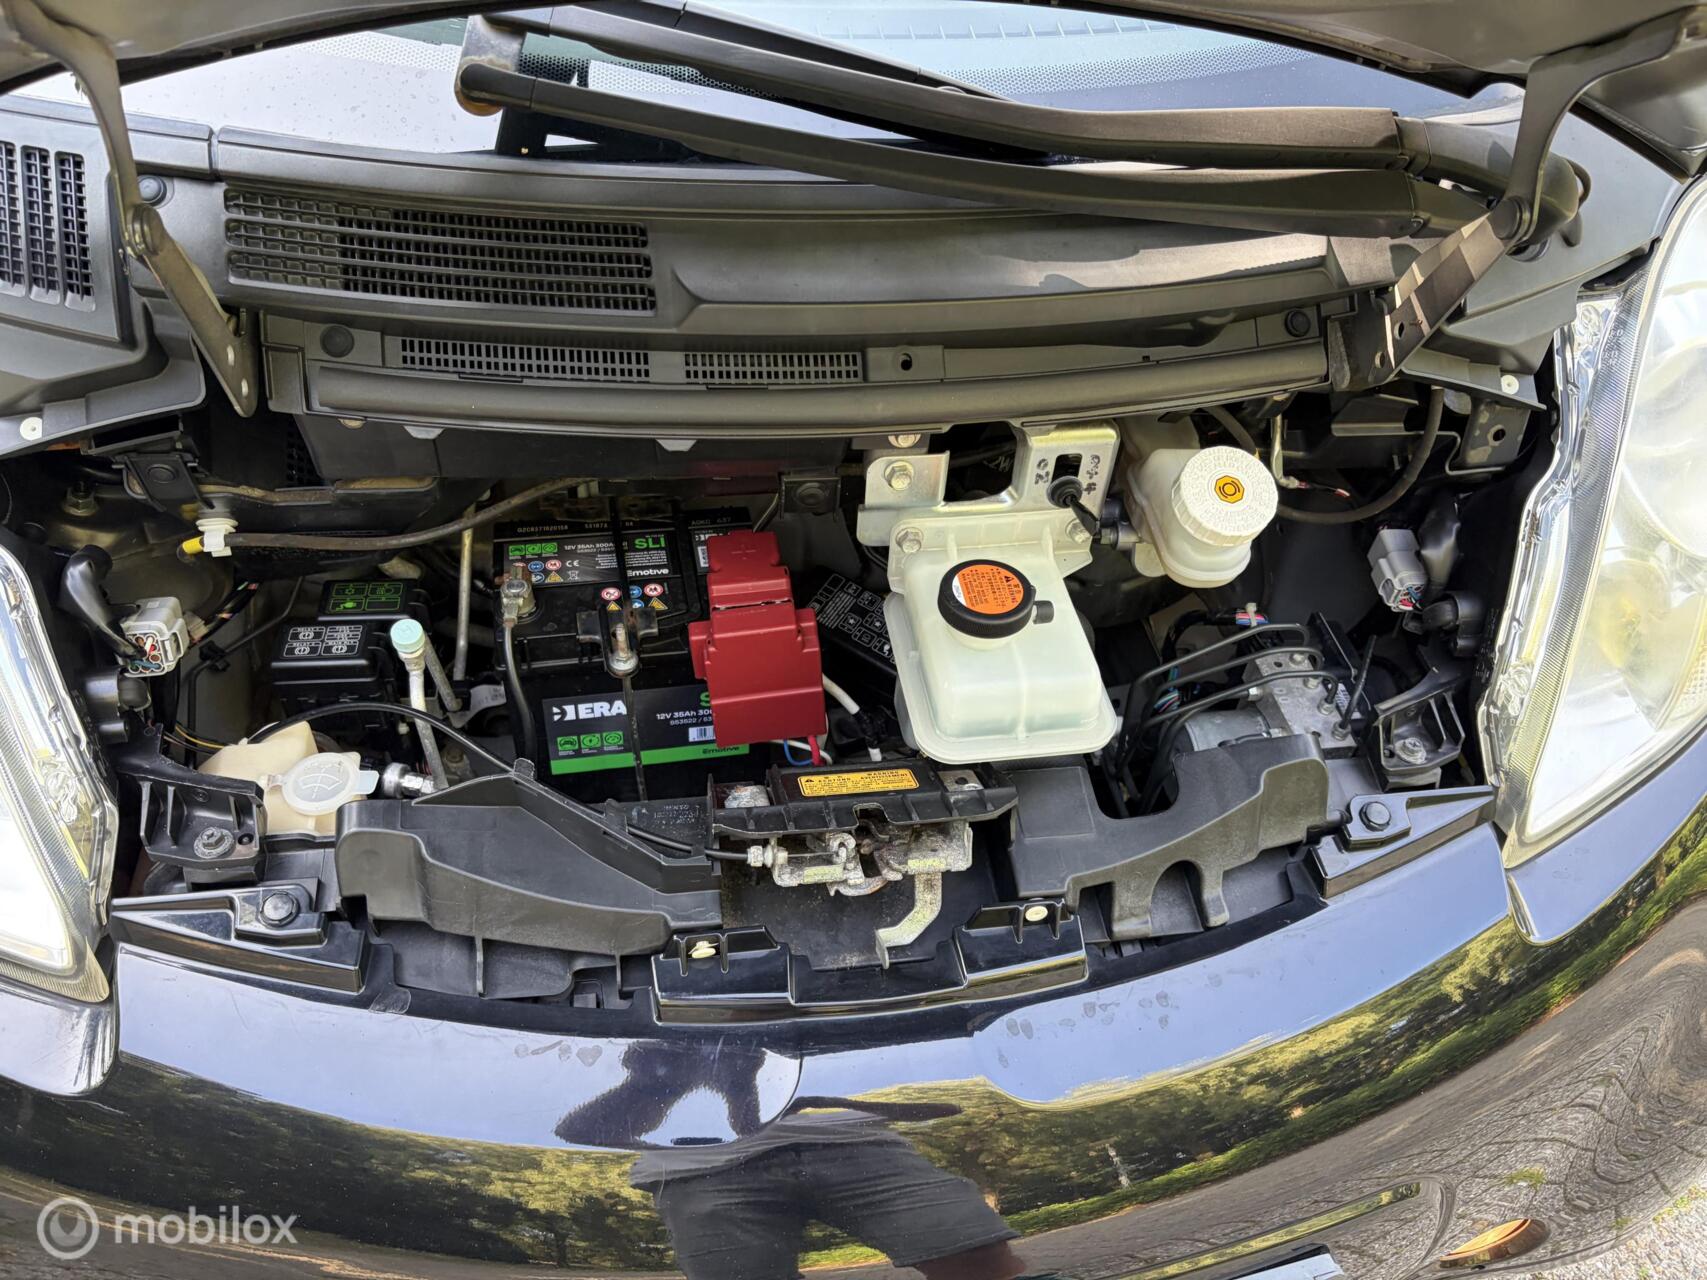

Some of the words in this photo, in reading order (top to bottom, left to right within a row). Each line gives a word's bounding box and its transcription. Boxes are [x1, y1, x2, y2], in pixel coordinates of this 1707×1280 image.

[634, 537, 666, 550] SLI
[578, 700, 627, 720] ERA
[656, 712, 672, 720] 12V
[673, 710, 696, 719] 35Ah
